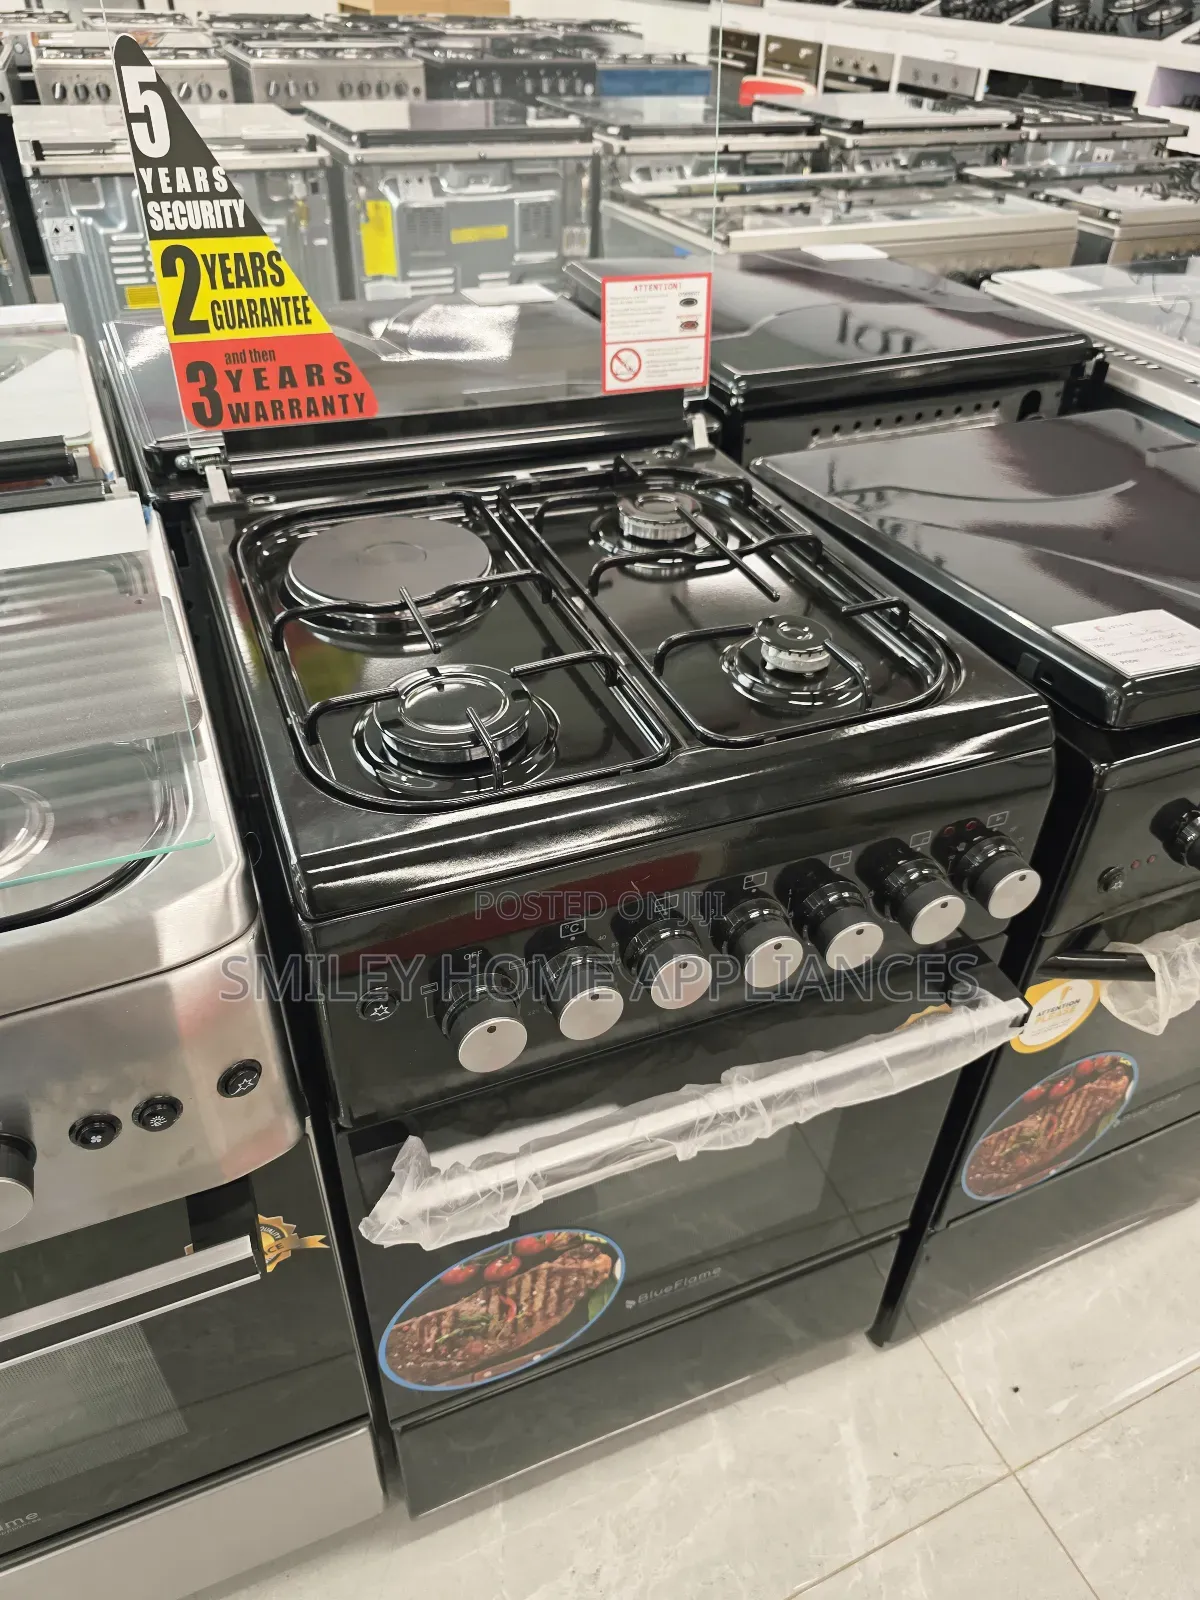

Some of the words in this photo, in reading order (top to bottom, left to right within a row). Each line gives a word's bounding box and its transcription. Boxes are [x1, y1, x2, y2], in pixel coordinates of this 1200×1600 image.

[121, 65, 171, 159] 5
[139, 165, 229, 194] YEARS
[147, 198, 246, 231] SECURITY
[161, 244, 211, 335] 2
[201, 250, 286, 290] YEARS
[211, 295, 313, 331] GUARANTEE
[225, 351, 247, 366] and
[249, 348, 277, 364] then
[185, 360, 224, 428] 3
[224, 361, 353, 393] YEARS
[228, 392, 366, 425] WARRANTY
[463, 949, 484, 961] OFF
[1036, 998, 1081, 1017] ATTENTION
[637, 1266, 722, 1304] BlueFlame
